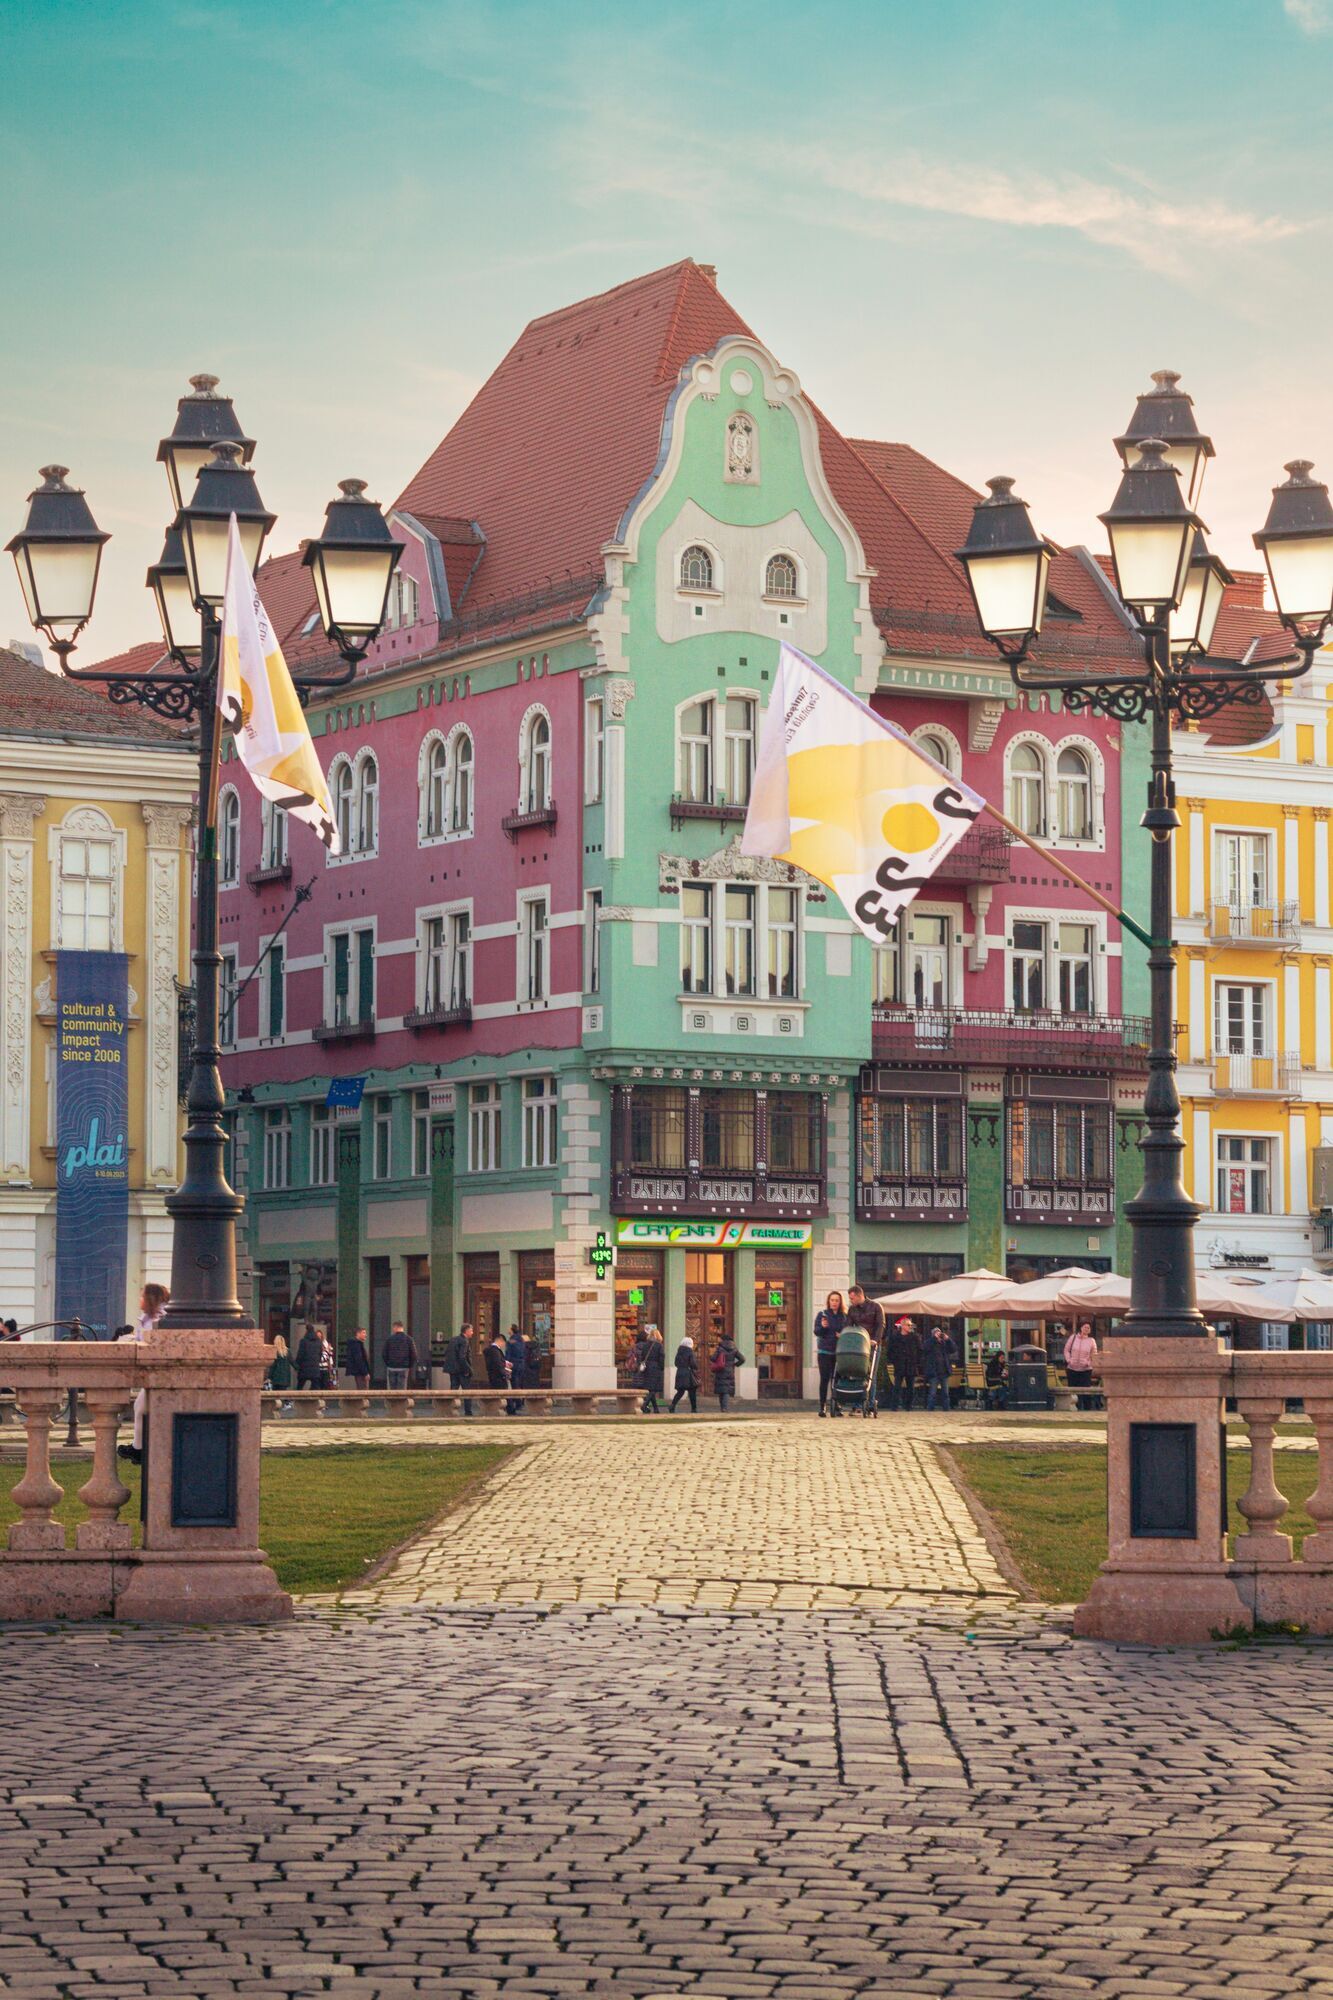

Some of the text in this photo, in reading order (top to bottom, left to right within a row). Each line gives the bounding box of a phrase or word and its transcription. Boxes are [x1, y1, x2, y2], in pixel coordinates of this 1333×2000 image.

[62, 1003, 116, 1016] cultural &
[62, 1019, 124, 1035] community
[62, 1032, 101, 1048] impact
[62, 1048, 121, 1062] since 2006
[62, 1117, 125, 1177] plai
[634, 1224, 804, 1239] CATENA FARMACIE
